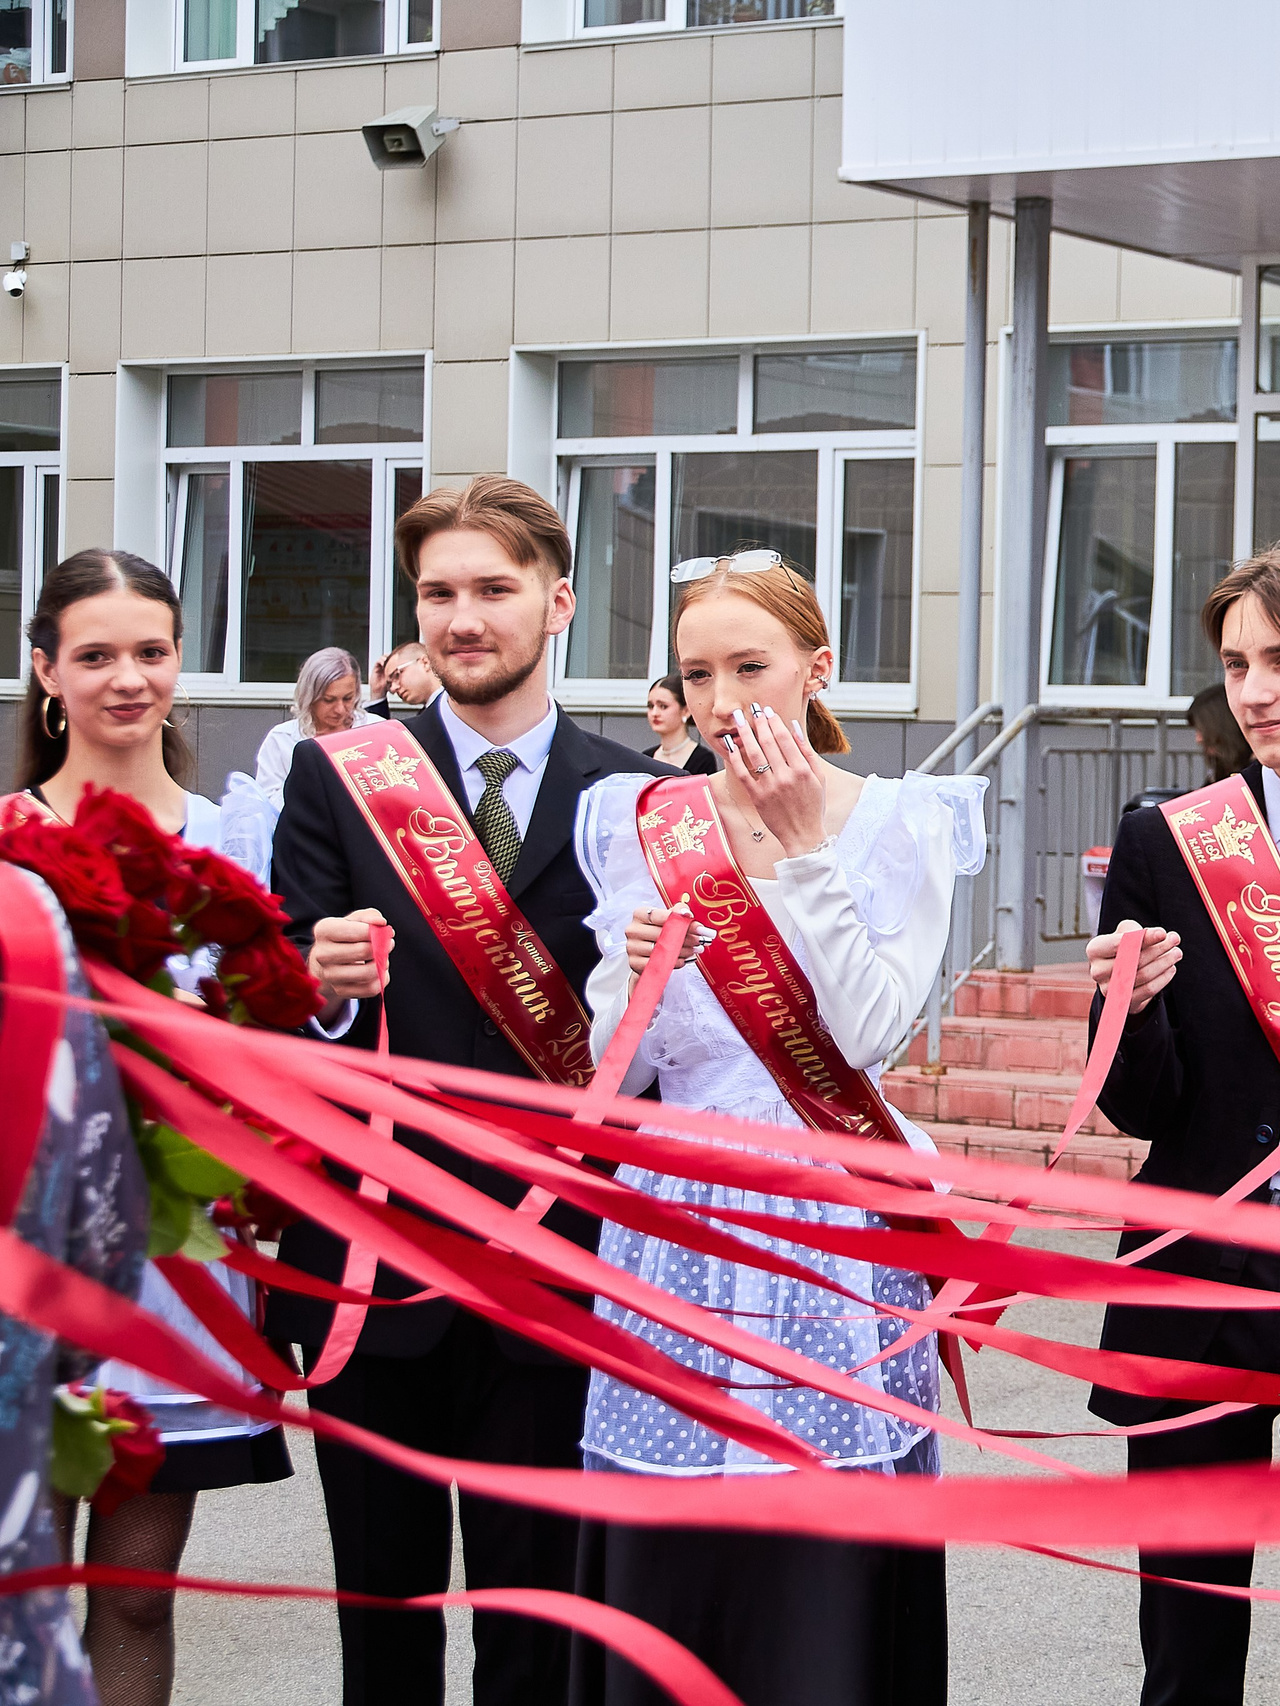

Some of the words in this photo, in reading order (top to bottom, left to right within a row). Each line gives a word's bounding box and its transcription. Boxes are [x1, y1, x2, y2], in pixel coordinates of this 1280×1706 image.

[408, 805, 556, 1024] Выпускник
[474, 860, 510, 918] Дерюгин
[511, 919, 556, 976] Матвей
[693, 870, 841, 1104] Выпускница
[762, 935, 809, 1006] Данилкина
